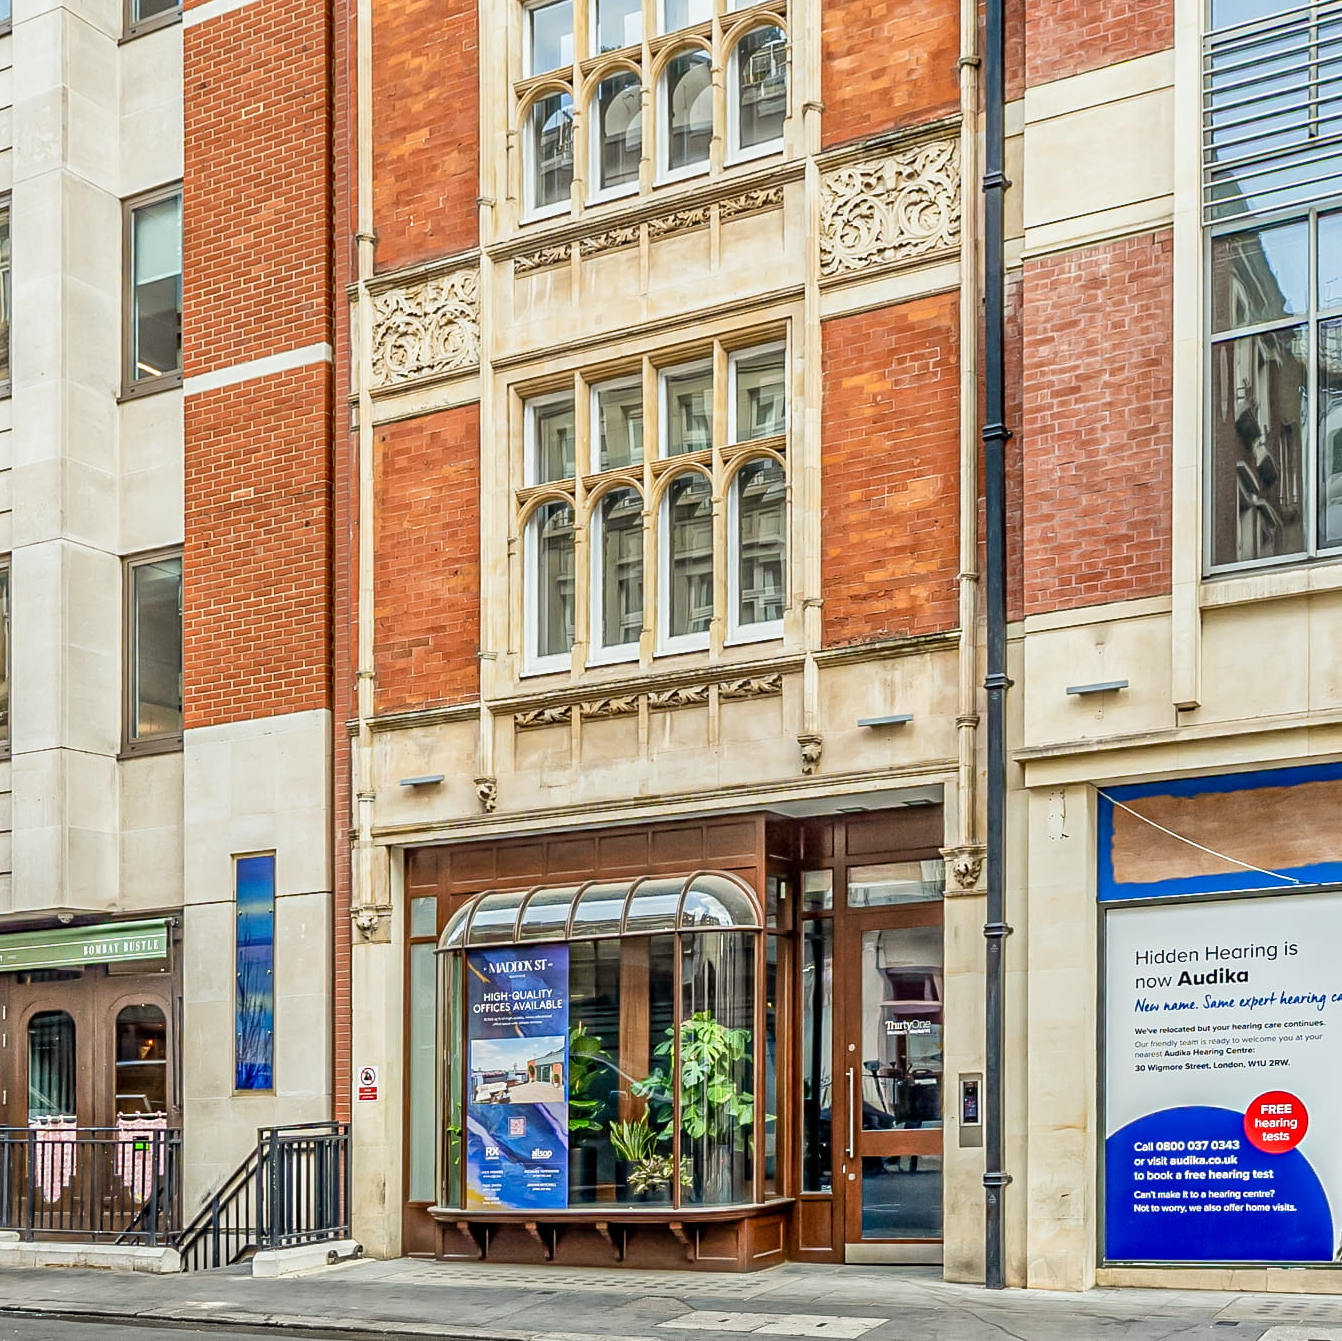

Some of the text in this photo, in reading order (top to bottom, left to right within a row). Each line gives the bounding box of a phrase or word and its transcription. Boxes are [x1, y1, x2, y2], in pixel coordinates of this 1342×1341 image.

[83, 940, 158, 955] BOMBAY BUSTLE
[1135, 941, 1298, 965] Hidden Hearing is
[489, 959, 547, 973] MADDOX ST
[1135, 968, 1249, 988] now Audika
[484, 989, 552, 1001] HIGH-QUALITY
[473, 999, 562, 1013] OFFICES AVAILABLE
[1135, 998, 1159, 1012] New
[1163, 1000, 1198, 1010] name.
[1203, 995, 1235, 1009] Same
[1239, 992, 1276, 1010] expert
[1280, 991, 1326, 1011] hearing
[885, 1020, 931, 1030] ThirtyOne
[1135, 1027, 1158, 1035] We've
[1159, 1025, 1195, 1033] relocated
[1212, 1024, 1230, 1033] your
[1232, 1022, 1262, 1031] hearing
[1284, 1019, 1326, 1028] continues.
[1150, 1038, 1178, 1049] friendly
[1208, 1036, 1230, 1046] ready
[1232, 1035, 1240, 1044] to
[1242, 1034, 1276, 1043] welcome
[1279, 1034, 1293, 1043] you
[1305, 1033, 1323, 1042] your
[1135, 1050, 1162, 1058] nearest
[1164, 1049, 1191, 1057] Audika
[1193, 1048, 1223, 1057] Hearing
[1147, 1063, 1183, 1073] Wigmore
[1185, 1062, 1211, 1071] Street,
[1213, 1061, 1246, 1069] London,
[1269, 1059, 1290, 1067] 2RW.
[1261, 1104, 1292, 1115] FREE
[1255, 1117, 1298, 1129] hearing
[1262, 1131, 1289, 1141] tests
[486, 1147, 499, 1156] RX
[1134, 1140, 1240, 1152] Call 0800 037 0343
[1134, 1155, 1237, 1166] or visit audika.co.uk
[1134, 1169, 1274, 1181] to book a free hearing test
[1134, 1190, 1156, 1199] Can't
[1158, 1190, 1180, 1198] make
[1183, 1190, 1188, 1198] it
[1190, 1190, 1199, 1198] to
[1209, 1190, 1240, 1199] hearing
[1243, 1189, 1275, 1198] centre?
[1134, 1204, 1149, 1212] Not
[1151, 1204, 1159, 1212] to
[1161, 1204, 1187, 1213] worry,
[1204, 1203, 1221, 1212] also
[1224, 1203, 1243, 1212] offer
[1246, 1203, 1270, 1211] home
[1272, 1203, 1297, 1211] visits.
